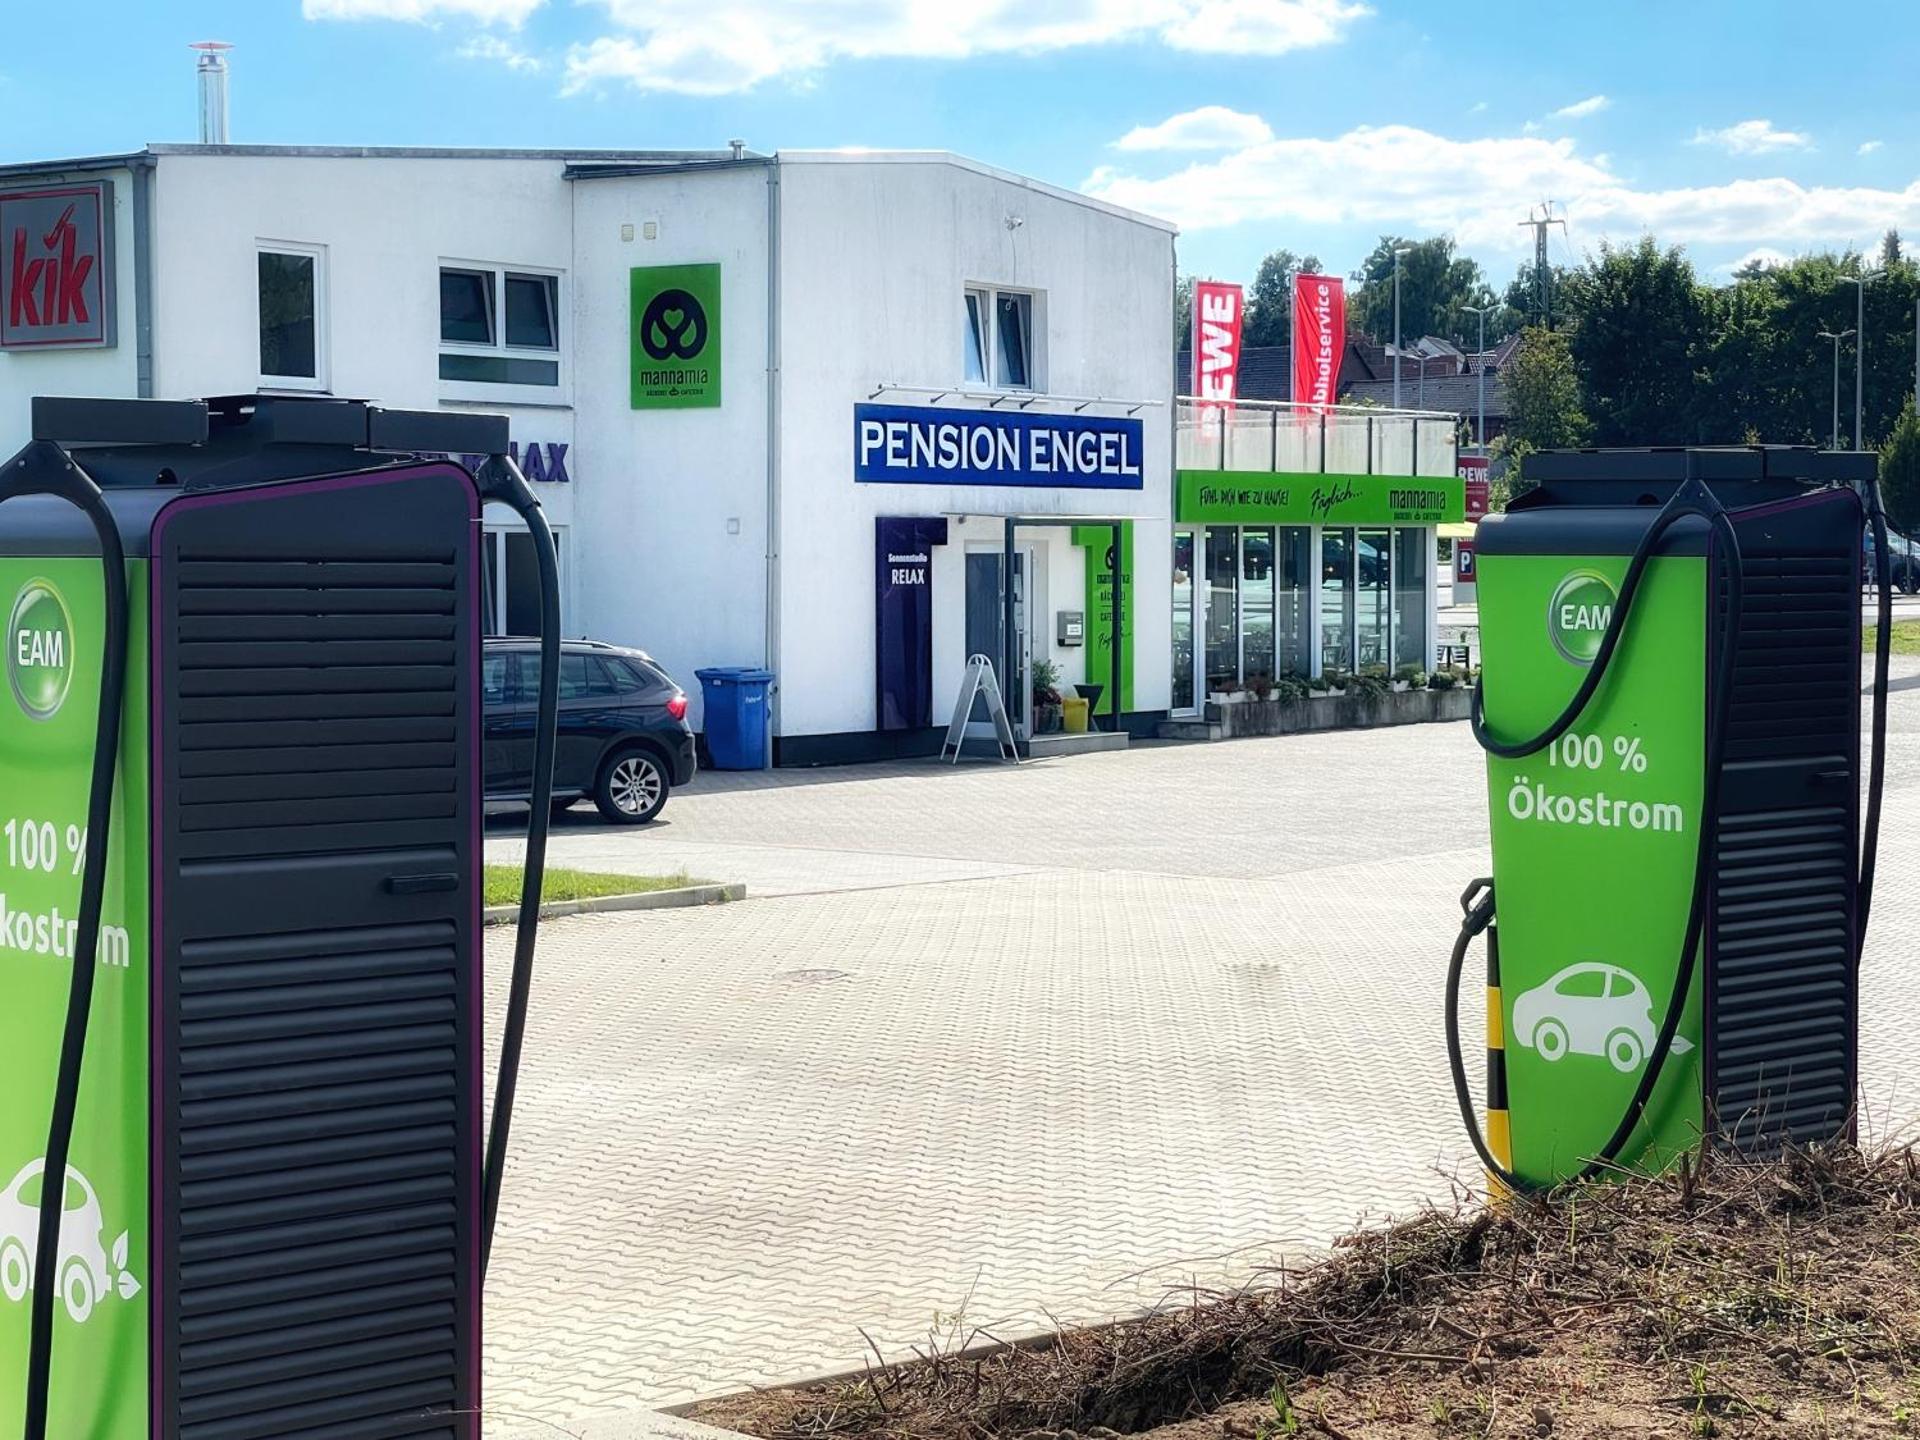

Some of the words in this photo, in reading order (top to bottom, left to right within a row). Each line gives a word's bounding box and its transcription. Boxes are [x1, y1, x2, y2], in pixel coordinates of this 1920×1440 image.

[10, 204, 94, 327] kik
[640, 369, 709, 385] mannamia
[860, 420, 1020, 472] PENSION
[1030, 429, 1139, 476] ENGEL
[1389, 489, 1447, 510] mannamia
[891, 568, 925, 585] RELAX
[1460, 551, 1471, 572] P
[1560, 604, 1612, 631] EAM
[18, 629, 64, 668] EAM
[1549, 733, 1604, 770] 100
[1613, 735, 1648, 773] %
[1508, 775, 1684, 832] Ökostrom
[4, 818, 57, 873] 100
